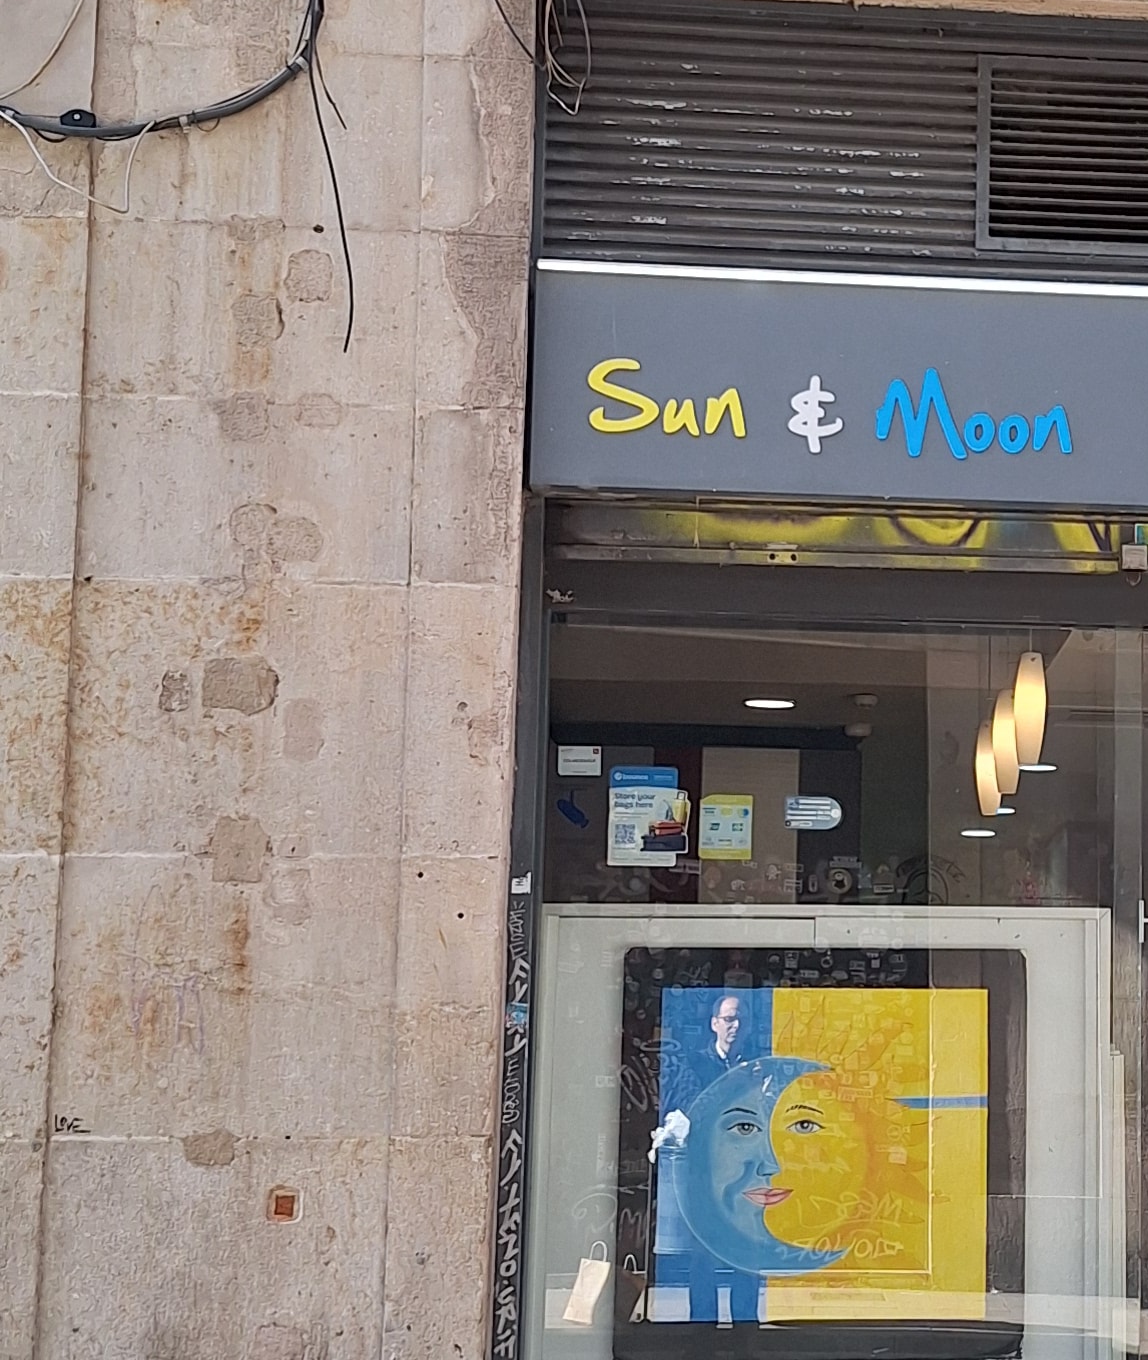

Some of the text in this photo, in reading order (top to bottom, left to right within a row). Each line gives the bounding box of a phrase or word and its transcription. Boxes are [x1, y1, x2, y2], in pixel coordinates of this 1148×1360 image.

[586, 357, 1073, 460] Sun & Moon
[55, 1114, 91, 1133] LOVE
